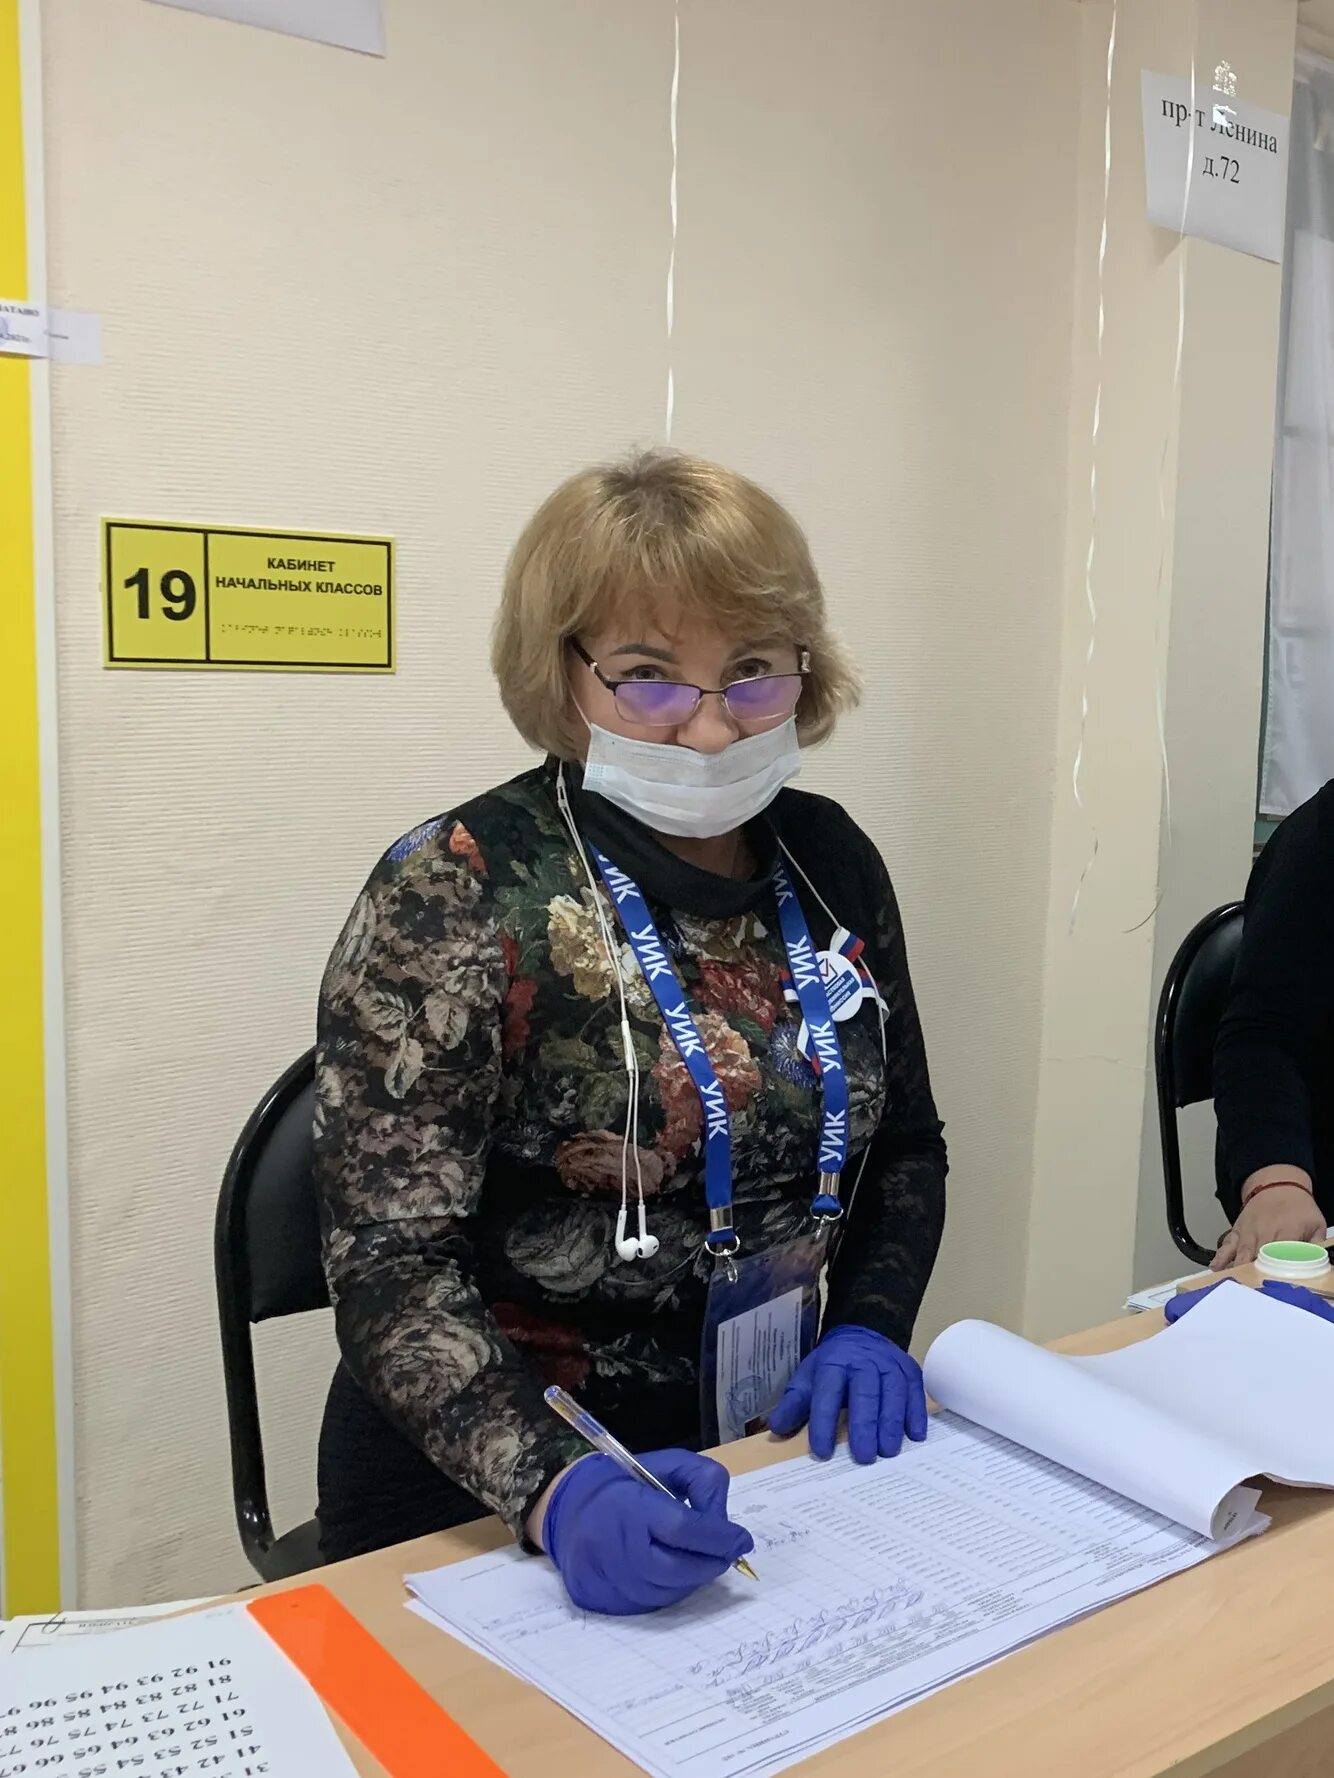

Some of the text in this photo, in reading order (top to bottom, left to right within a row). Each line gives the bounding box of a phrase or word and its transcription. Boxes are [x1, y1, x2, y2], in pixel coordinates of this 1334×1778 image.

[1202, 156, 1240, 183] д.72
[267, 557, 335, 573] КАБИНЕТ
[124, 567, 196, 621] 19
[215, 576, 383, 596] НАЧАЛЬНЫХ КЛАССОВ
[772, 861, 794, 908] УИ
[631, 923, 673, 982] УИК
[786, 934, 820, 990] УИК
[664, 1001, 705, 1058] УИК
[809, 1020, 842, 1074] УИК
[700, 1079, 728, 1141] УИК
[819, 1108, 846, 1163] УИК
[170, 1665, 199, 1678] 92
[207, 1657, 232, 1670] 91
[100, 1682, 130, 1696] 94
[136, 1673, 164, 1687] 93
[28, 1699, 58, 1711] 96
[65, 1690, 94, 1704] 95
[214, 1691, 240, 1705] 71
[0, 1674, 232, 1739] 81 82 83 84 85 86 8
[176, 1700, 205, 1714] 72
[104, 1718, 133, 1732] 74
[141, 1709, 169, 1724] 73
[29, 1735, 60, 1748] 76
[67, 1726, 97, 1741] 75
[0, 1708, 247, 1778] 61 62 63 64 65 66 67
[78, 1725, 254, 1778] 51 52 53 54 55
[159, 1744, 262, 1778] 41 42 43
[244, 1761, 270, 1777] 31
